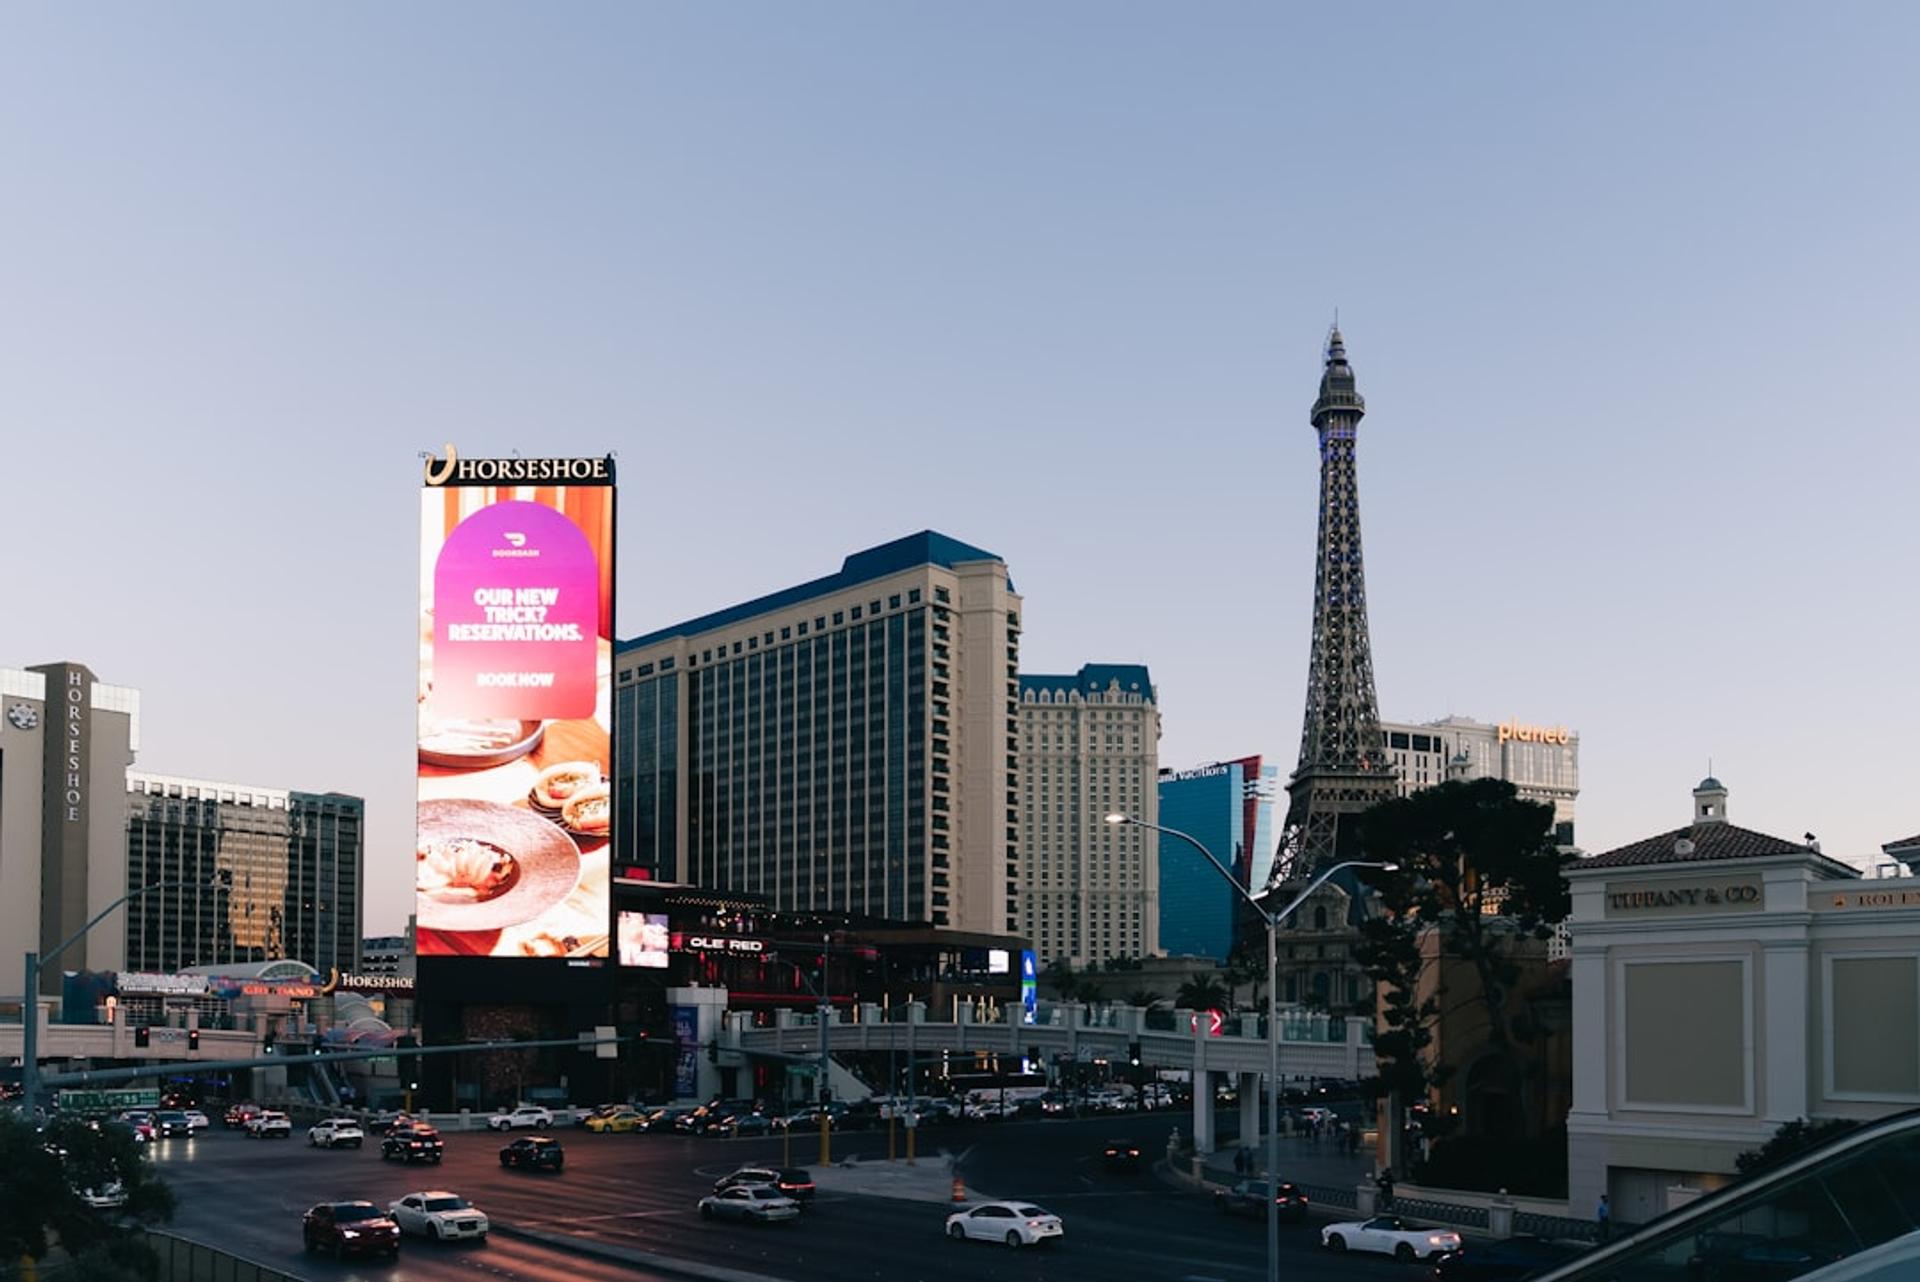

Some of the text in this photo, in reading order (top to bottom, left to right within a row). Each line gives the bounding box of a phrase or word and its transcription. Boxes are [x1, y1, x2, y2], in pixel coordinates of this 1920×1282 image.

[459, 460, 608, 480] HORSESHOE
[474, 588, 559, 606] OUR NEW
[484, 606, 547, 623] TRICK?
[448, 624, 583, 641] RESERVATIONS.
[476, 672, 554, 687] BOOK NOW
[67, 672, 82, 821] HORSESHOE
[1608, 888, 1700, 908] TIFFANY
[1705, 887, 1720, 904] &
[1857, 892, 1920, 906] ROLE
[689, 937, 763, 951] OLE RED
[342, 972, 414, 989] HORSESHOE
